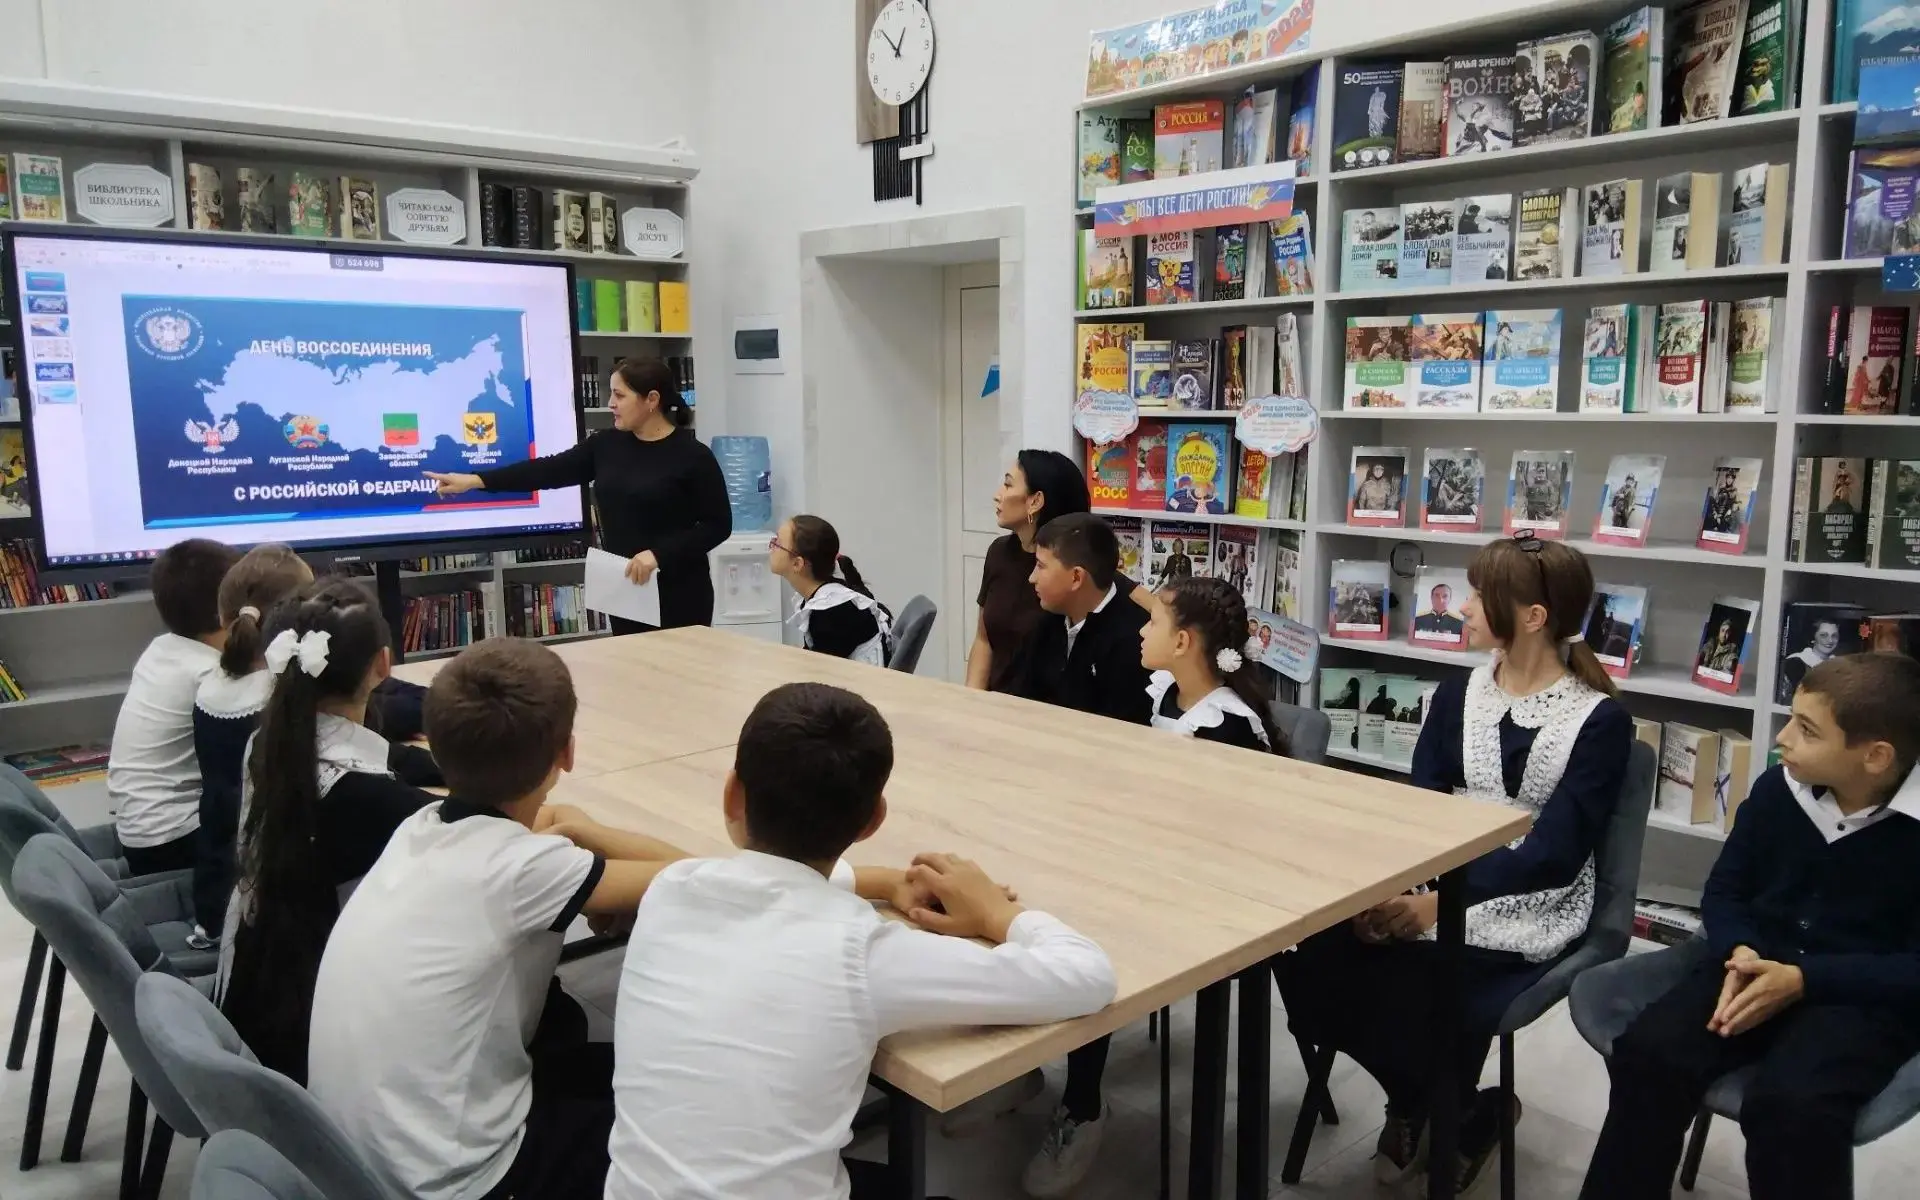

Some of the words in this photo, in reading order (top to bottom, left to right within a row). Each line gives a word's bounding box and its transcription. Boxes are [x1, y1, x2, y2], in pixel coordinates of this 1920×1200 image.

[920, 18, 926, 28] 2
[924, 40, 930, 50] 3
[1454, 59, 1478, 69] ИЛЬЯ
[873, 75, 879, 84] 8
[1343, 72, 1361, 85] 50
[1450, 68, 1514, 98] ВОЙН
[909, 83, 915, 92] 5
[895, 92, 901, 101] 6
[1171, 111, 1208, 126] РОССИЯ
[87, 184, 161, 196] БИБЛИОТЕКА
[88, 196, 161, 207] ШКОЛЬНИКА
[1136, 199, 1155, 218] МЫ
[1158, 196, 1177, 216] ВСЕ
[1179, 191, 1204, 214] ДЕТИ
[398, 202, 432, 212] ЧИТАЮ
[406, 212, 449, 222] СОВЕТУЮ
[407, 223, 449, 233] ДРУЗЬЯМ
[646, 222, 658, 231] НА
[637, 232, 669, 242] ДОСУГЕ
[1160, 231, 1181, 241] МОЯ
[1152, 241, 1189, 252] РОССИЯ
[1374, 242, 1398, 252] ДОРОГА
[1403, 238, 1451, 250] БЛОКАДНАЯ
[1402, 249, 1427, 261] КНИГА
[250, 340, 293, 355] ДЕНЬ
[297, 340, 432, 357] ВОССОЕДИНЕНИЯ
[1425, 366, 1468, 374] РАССКАЗЫ
[168, 458, 211, 469] Донецкой
[211, 456, 254, 466] Народной
[269, 455, 311, 465] Луганской
[311, 454, 350, 463] Народной
[389, 459, 419, 468] области
[468, 457, 497, 465] области
[187, 465, 237, 476] Республики
[288, 462, 334, 472] Республики
[233, 486, 246, 501] С
[250, 479, 360, 500] РОССИЙСКОЙ
[362, 479, 441, 497] ФЕДЕРАЦИ
[1093, 486, 1128, 500] РОСС
